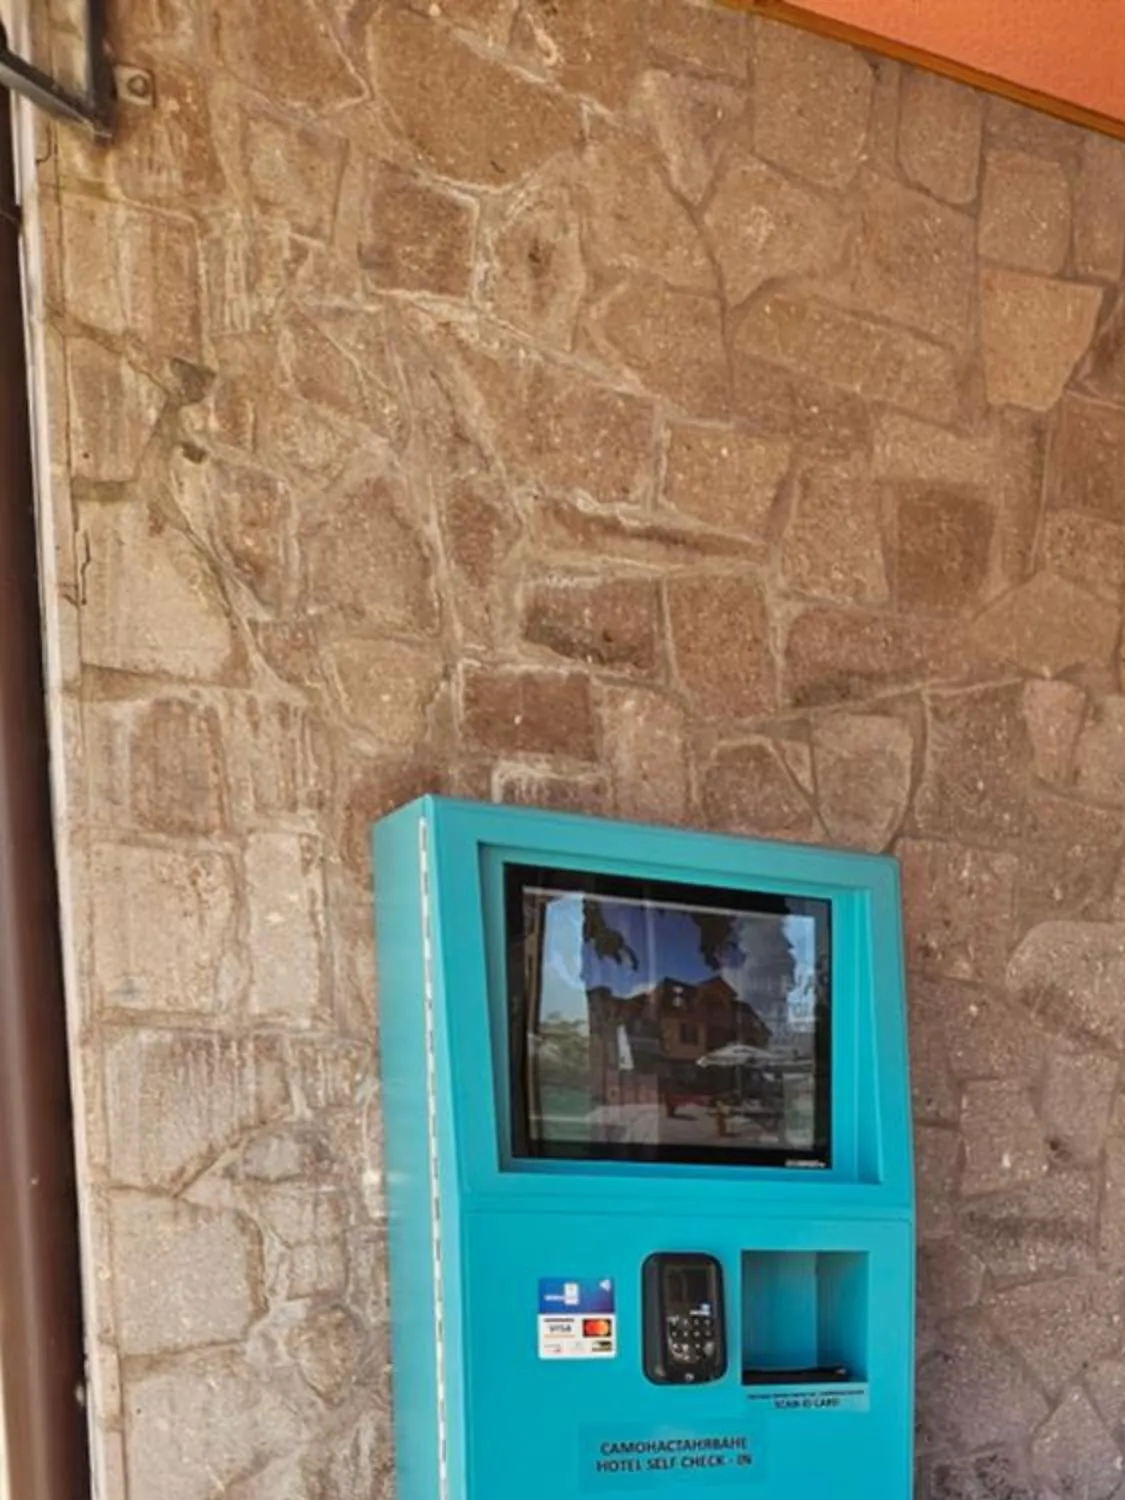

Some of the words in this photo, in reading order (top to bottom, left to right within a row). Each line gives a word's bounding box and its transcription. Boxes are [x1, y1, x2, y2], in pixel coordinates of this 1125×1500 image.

[599, 1436, 748, 1456] САМОНАСТАНЯВАНЕ
[596, 1458, 642, 1473] HOTEL
[646, 1456, 676, 1470] SELF
[681, 1454, 725, 1469] CHECK
[736, 1453, 752, 1466] IN
